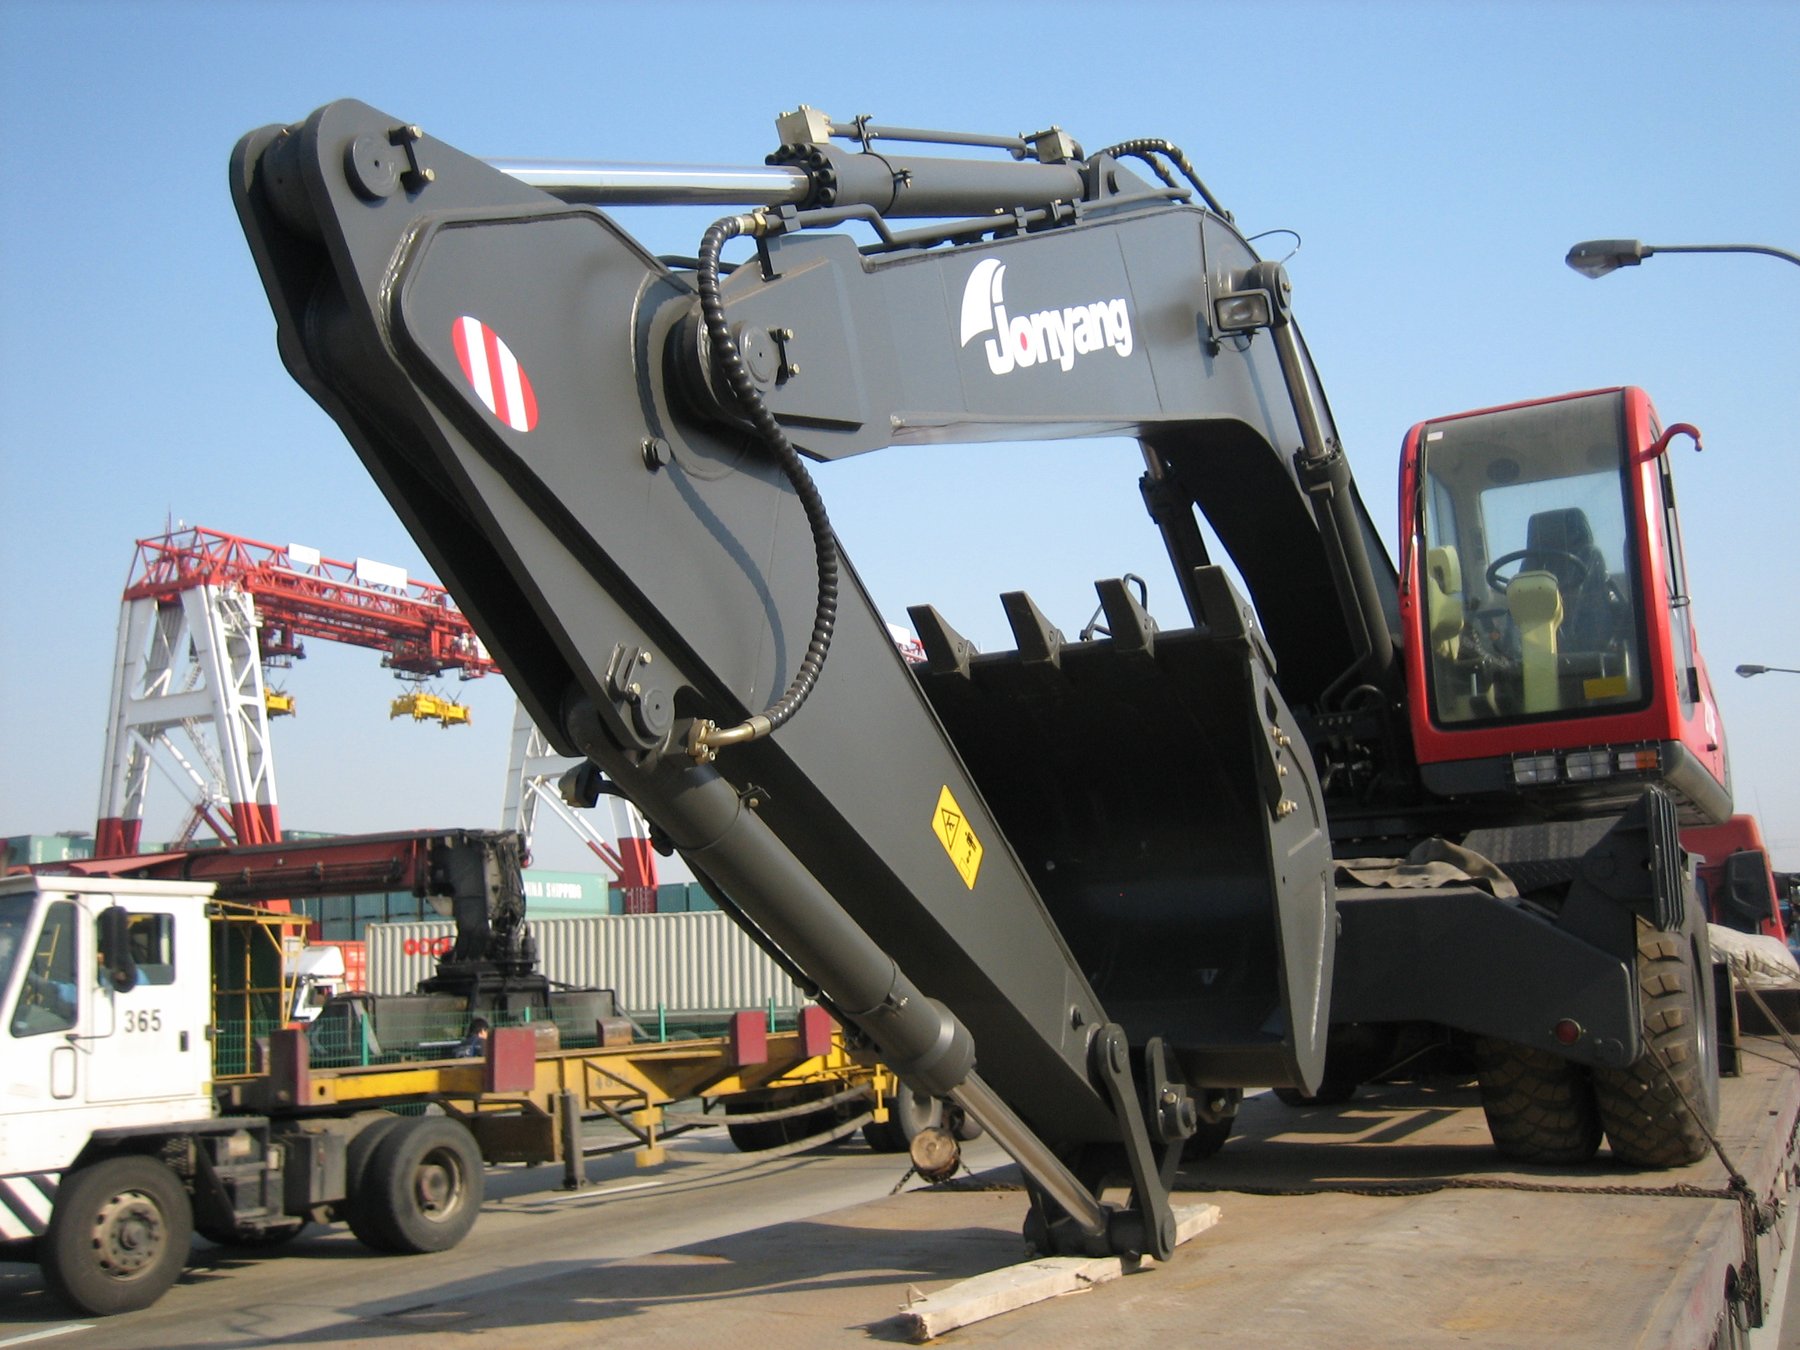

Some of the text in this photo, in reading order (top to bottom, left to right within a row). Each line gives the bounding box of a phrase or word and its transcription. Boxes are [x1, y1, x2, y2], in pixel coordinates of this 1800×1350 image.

[984, 298, 1133, 375] Jonyang
[546, 882, 582, 899] SHIPPING
[124, 1009, 162, 1033] 365
